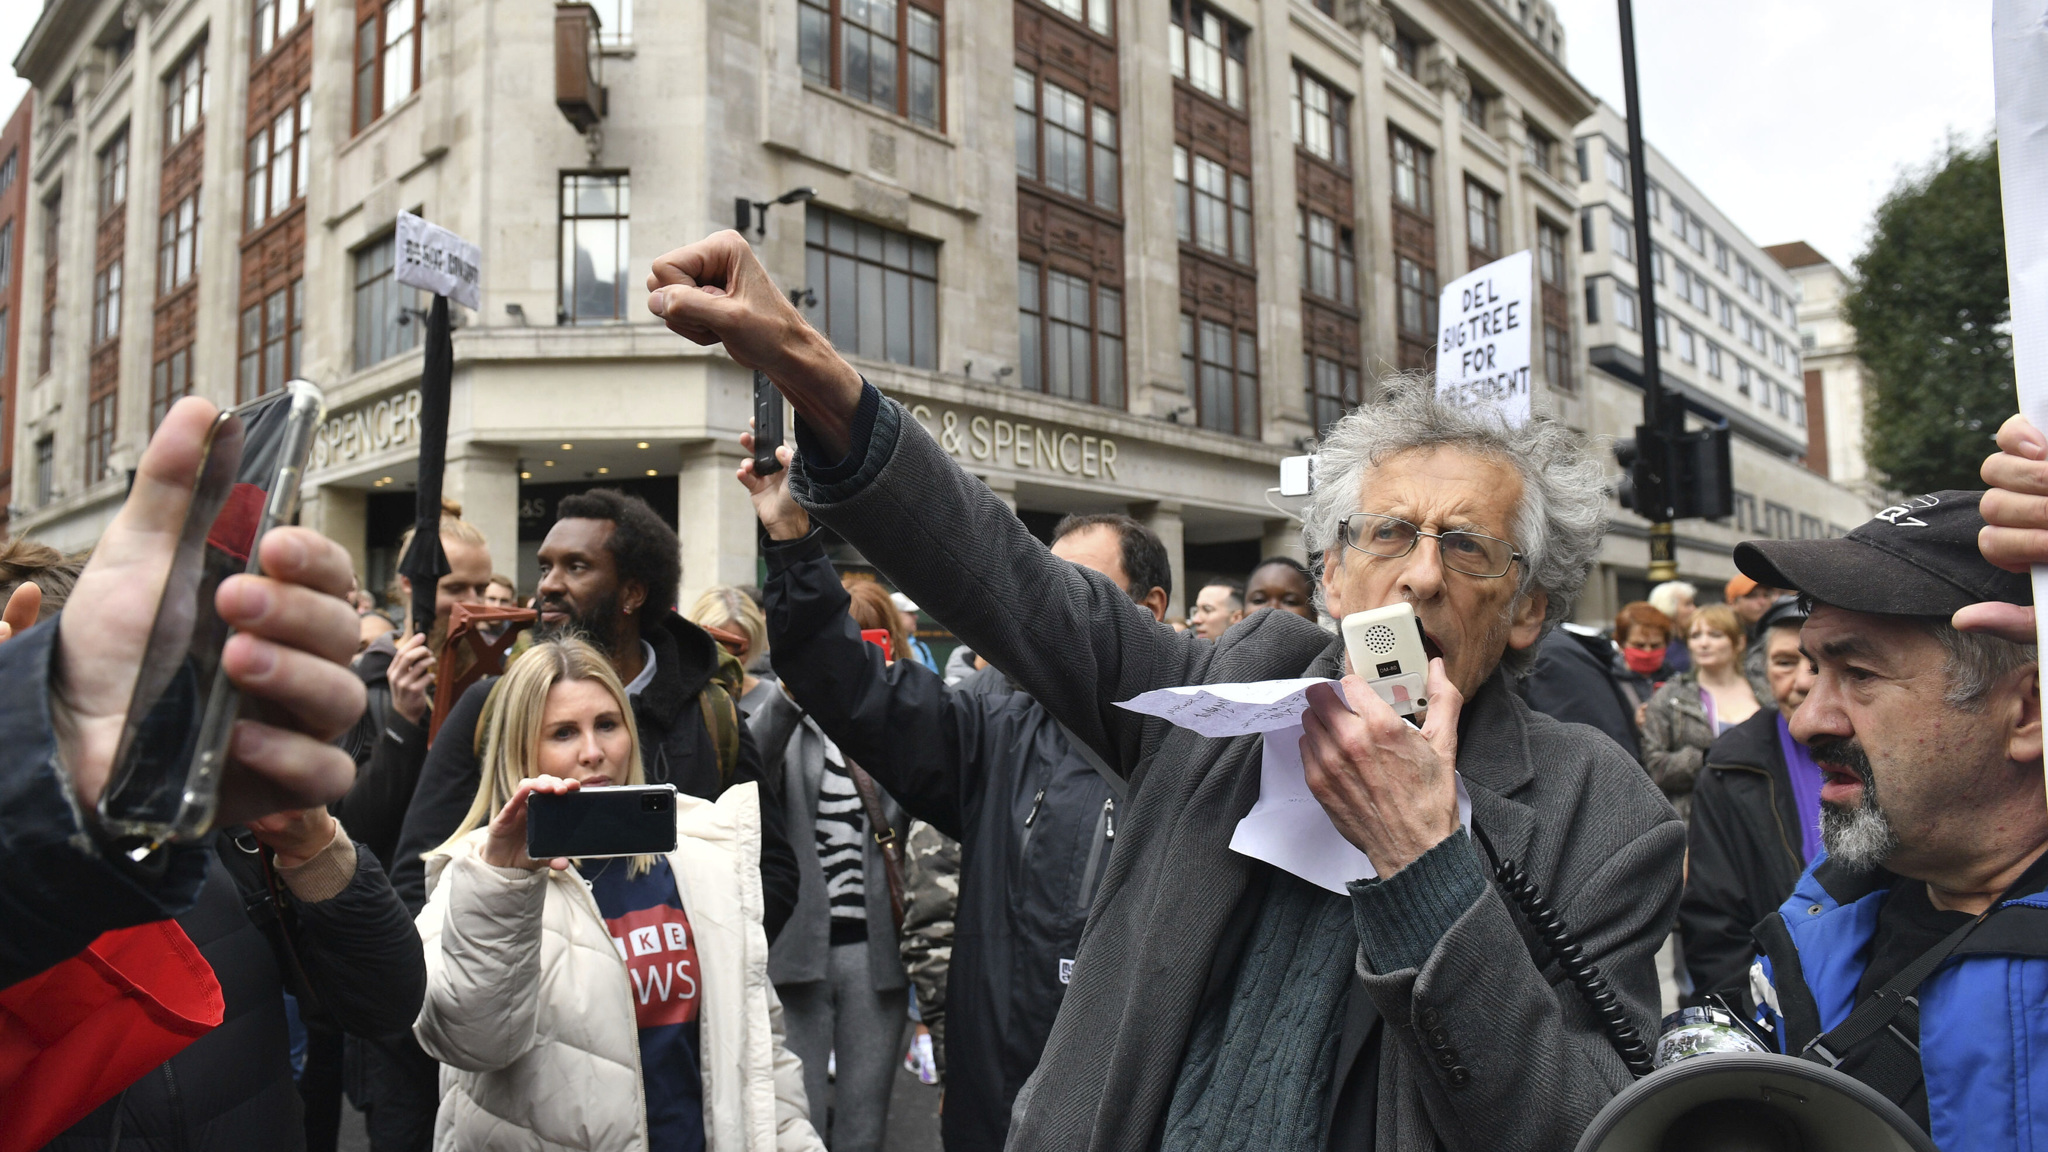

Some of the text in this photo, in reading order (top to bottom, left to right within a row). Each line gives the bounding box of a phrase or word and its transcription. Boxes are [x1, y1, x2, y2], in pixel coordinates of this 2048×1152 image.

[1462, 278, 1499, 313] DEL
[1462, 343, 1497, 378] FOR
[315, 388, 423, 468] SPENCER
[940, 410, 964, 455] &
[969, 415, 1119, 480] SPENCER
[519, 497, 546, 519] &S
[636, 926, 684, 953] KE
[629, 959, 697, 1006] WS
